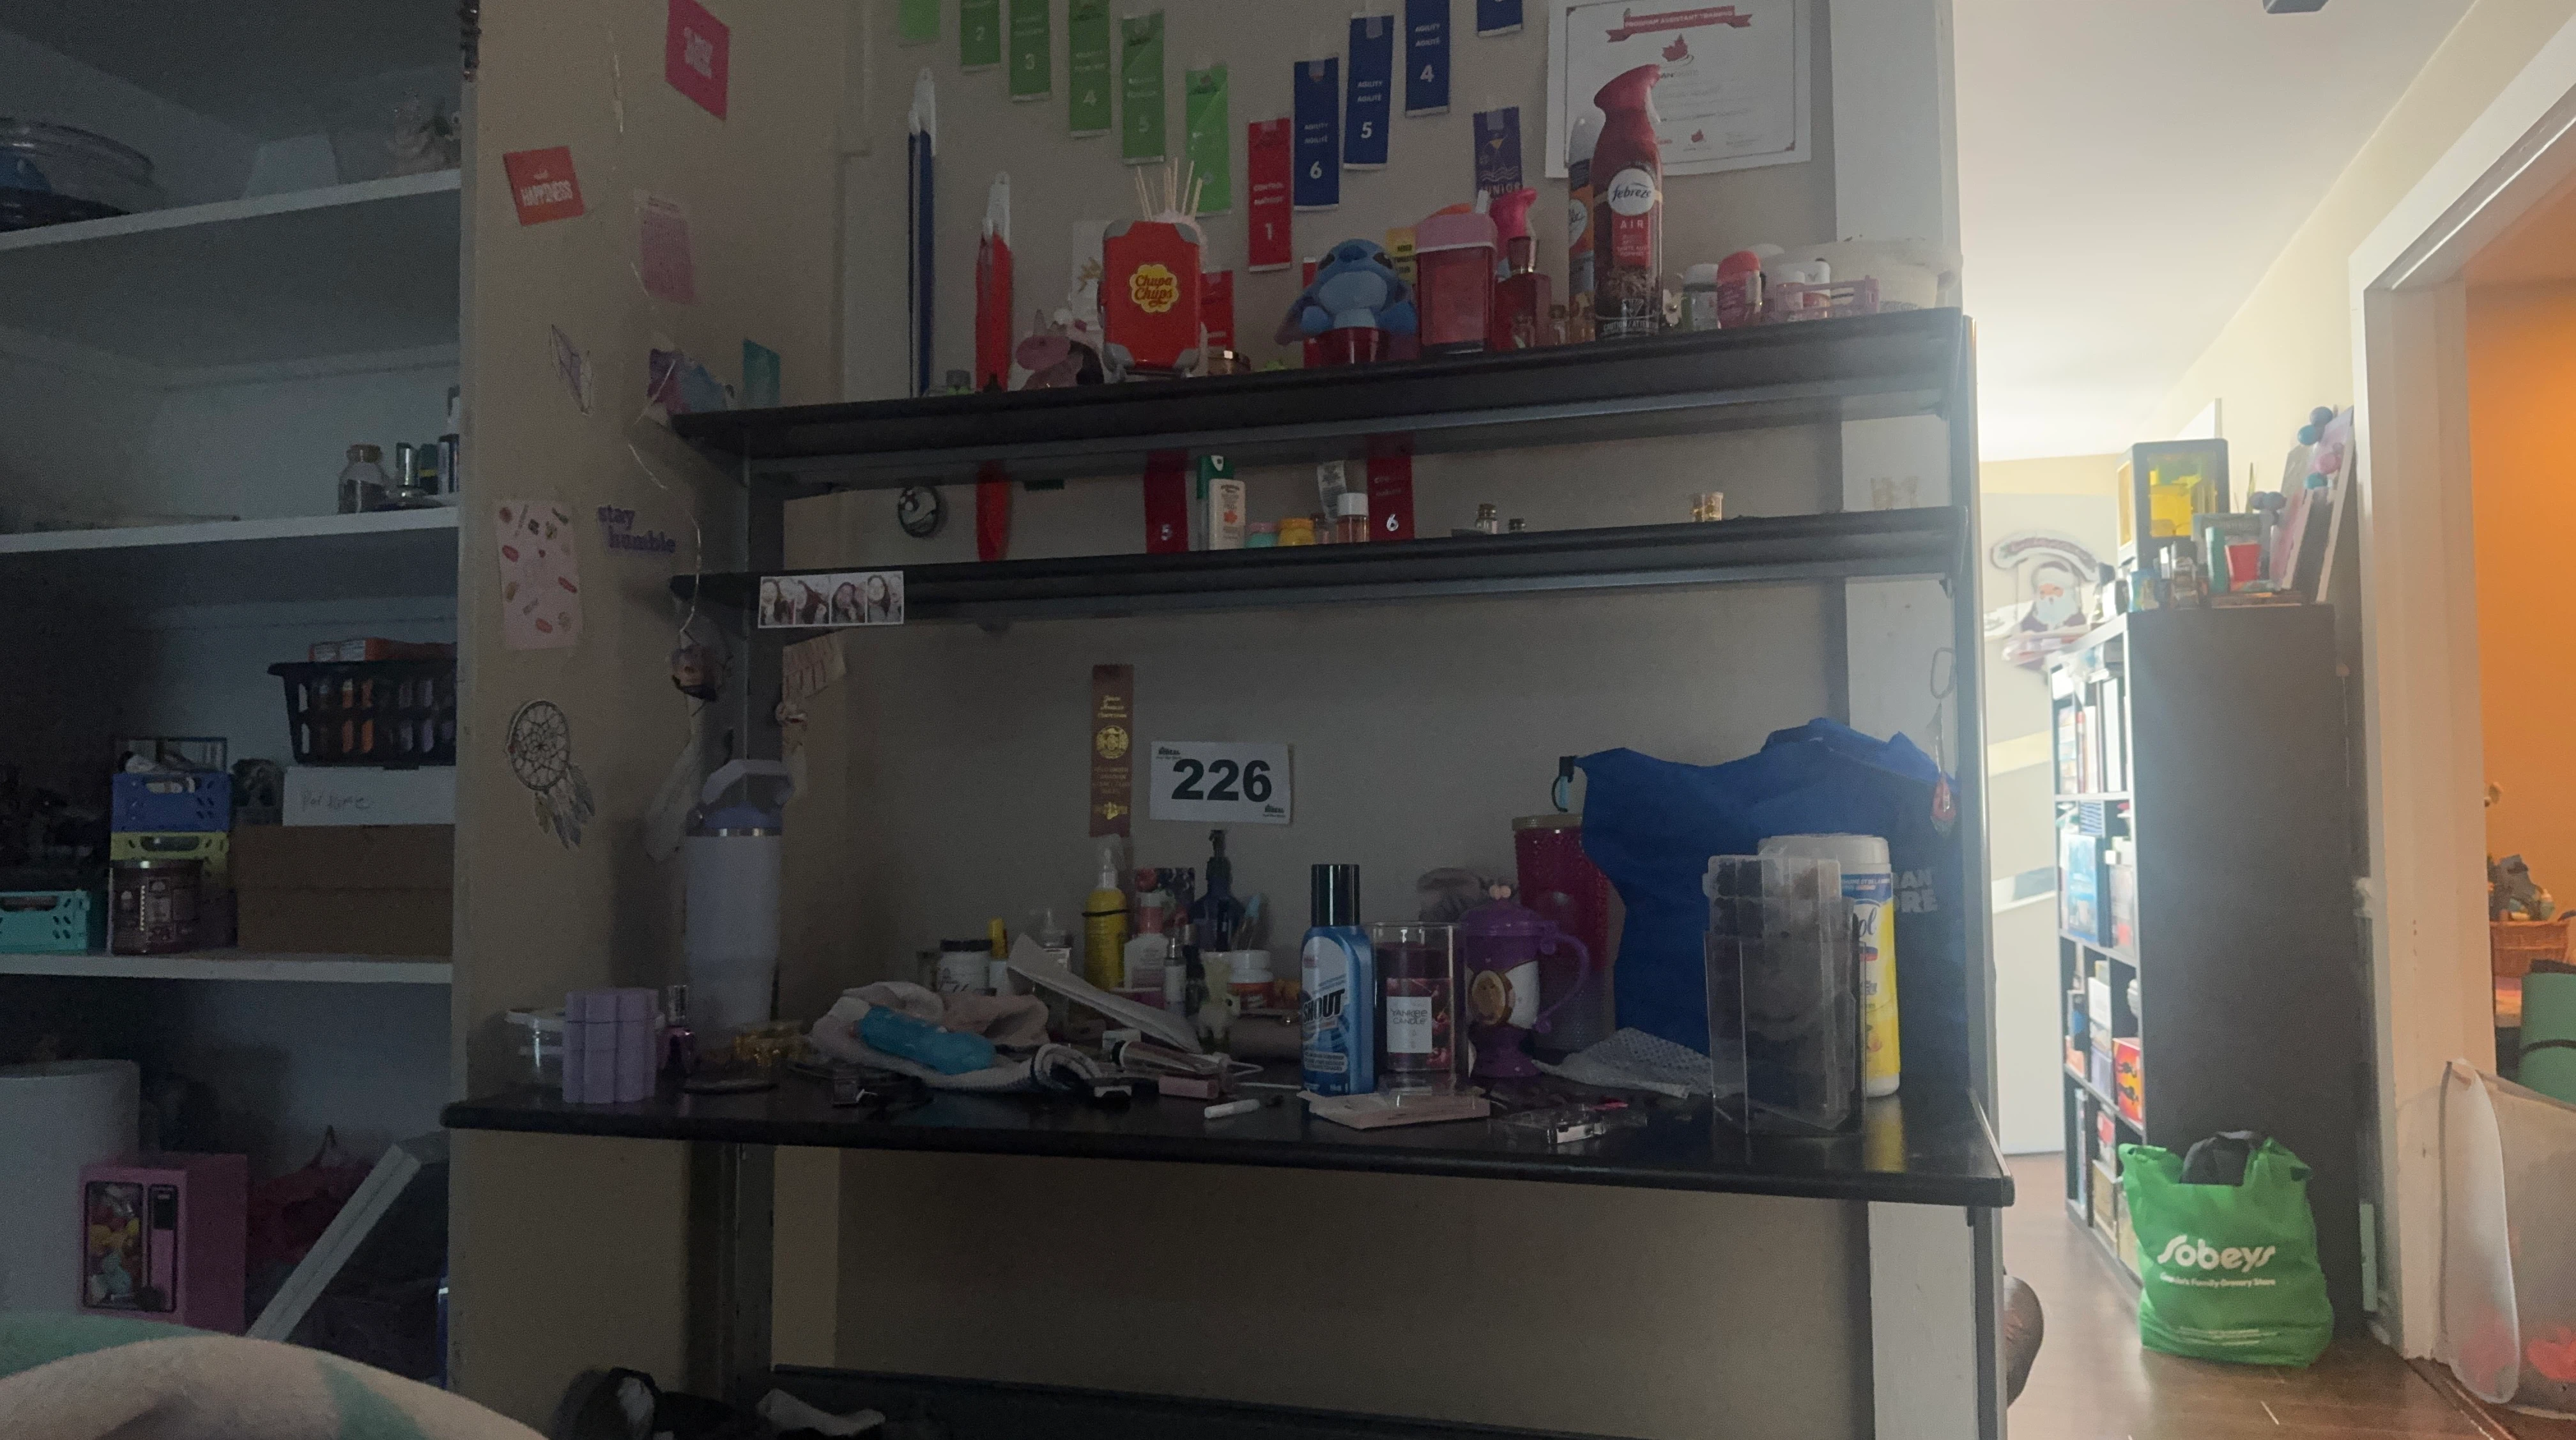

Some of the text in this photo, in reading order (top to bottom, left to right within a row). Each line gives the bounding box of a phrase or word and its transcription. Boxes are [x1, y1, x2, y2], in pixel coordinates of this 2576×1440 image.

[1415, 22, 1441, 33] AGILITY
[1660, 14, 1698, 24] ASSISTANT
[1420, 64, 1435, 83] 4
[1357, 80, 1383, 88] AGILITY
[1083, 89, 1098, 107] 4
[1304, 122, 1328, 130] AGILITY
[1360, 121, 1373, 139] 5
[1309, 160, 1322, 180] 6
[521, 180, 572, 206] HAPPINESS
[1481, 181, 1521, 195] UNIOR
[1612, 184, 1651, 202] febreze
[1264, 223, 1273, 240] 1
[1620, 219, 1644, 229] AIR
[1135, 274, 1173, 287] Chupa
[1135, 287, 1172, 307] Chups
[597, 504, 635, 530] stay
[1386, 513, 1399, 532] 6
[608, 525, 676, 553] humble
[1160, 523, 1174, 542] 5
[1171, 758, 1273, 803] 226
[1303, 988, 1346, 1023] SHOUT
[2157, 1234, 2276, 1273] Sobeys
